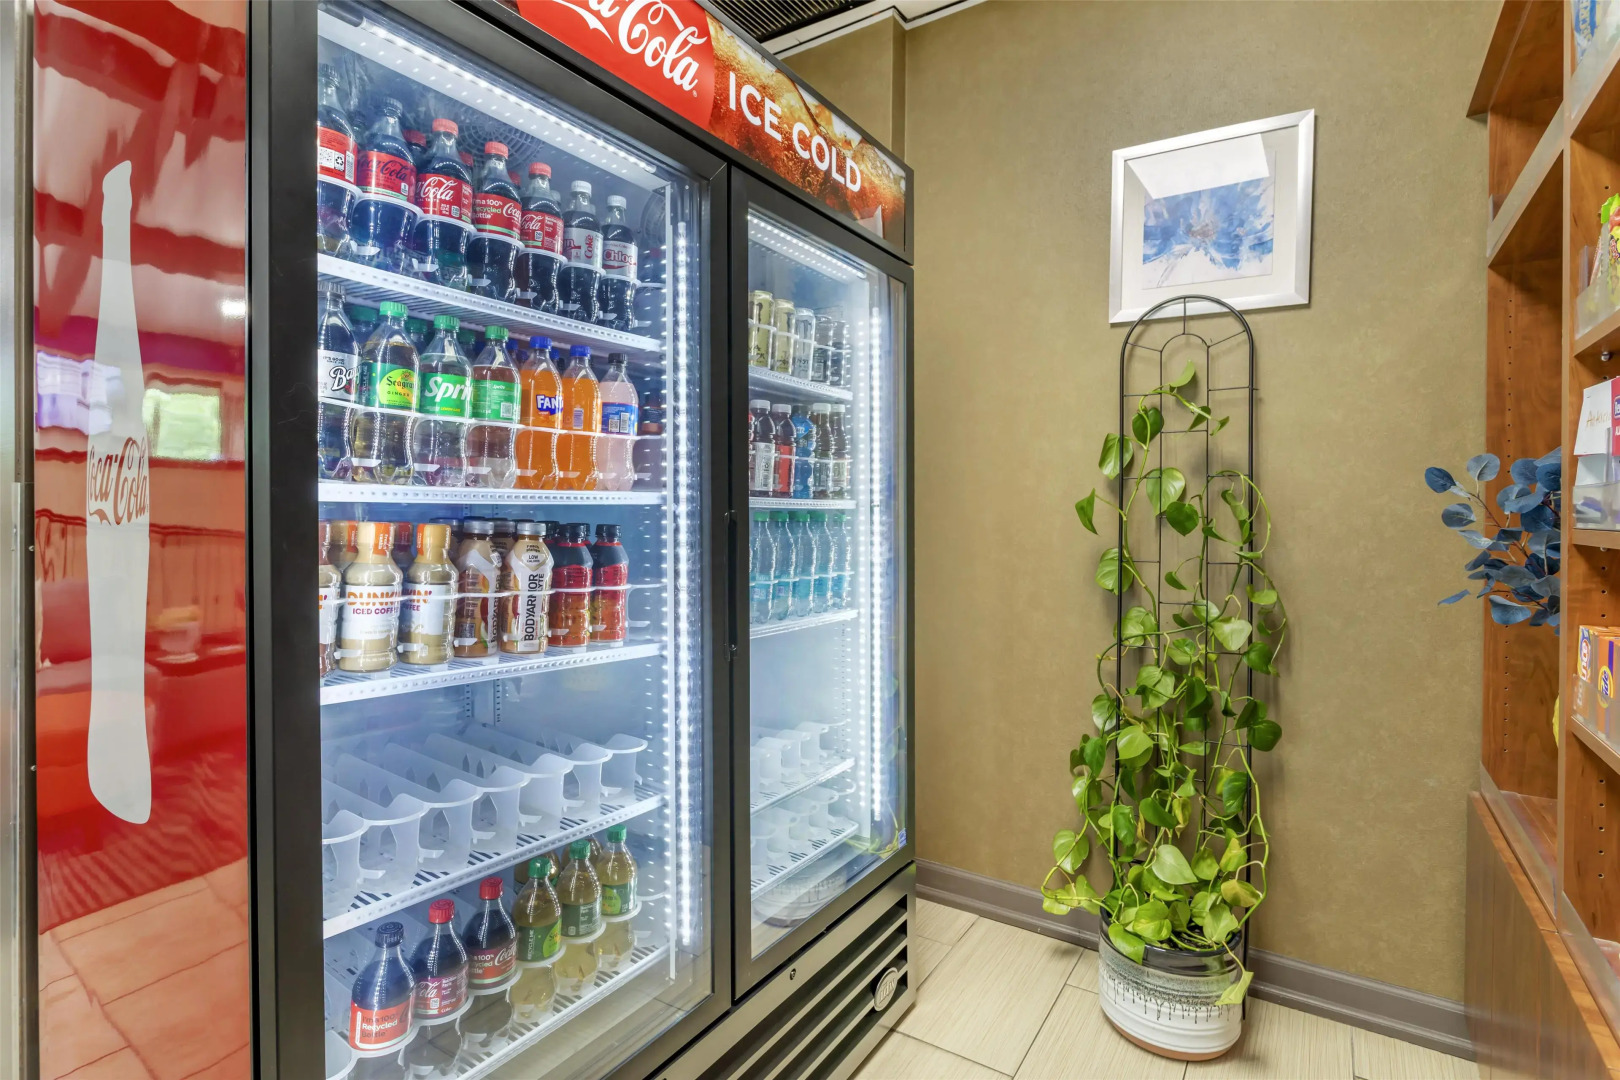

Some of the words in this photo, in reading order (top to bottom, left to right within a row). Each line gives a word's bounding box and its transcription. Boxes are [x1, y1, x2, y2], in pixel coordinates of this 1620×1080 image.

[729, 70, 783, 142] ICE
[792, 121, 862, 193] COLD
[584, 234, 594, 259] Coke
[424, 376, 471, 403] Spri
[361, 1019, 398, 1032] Recycled
